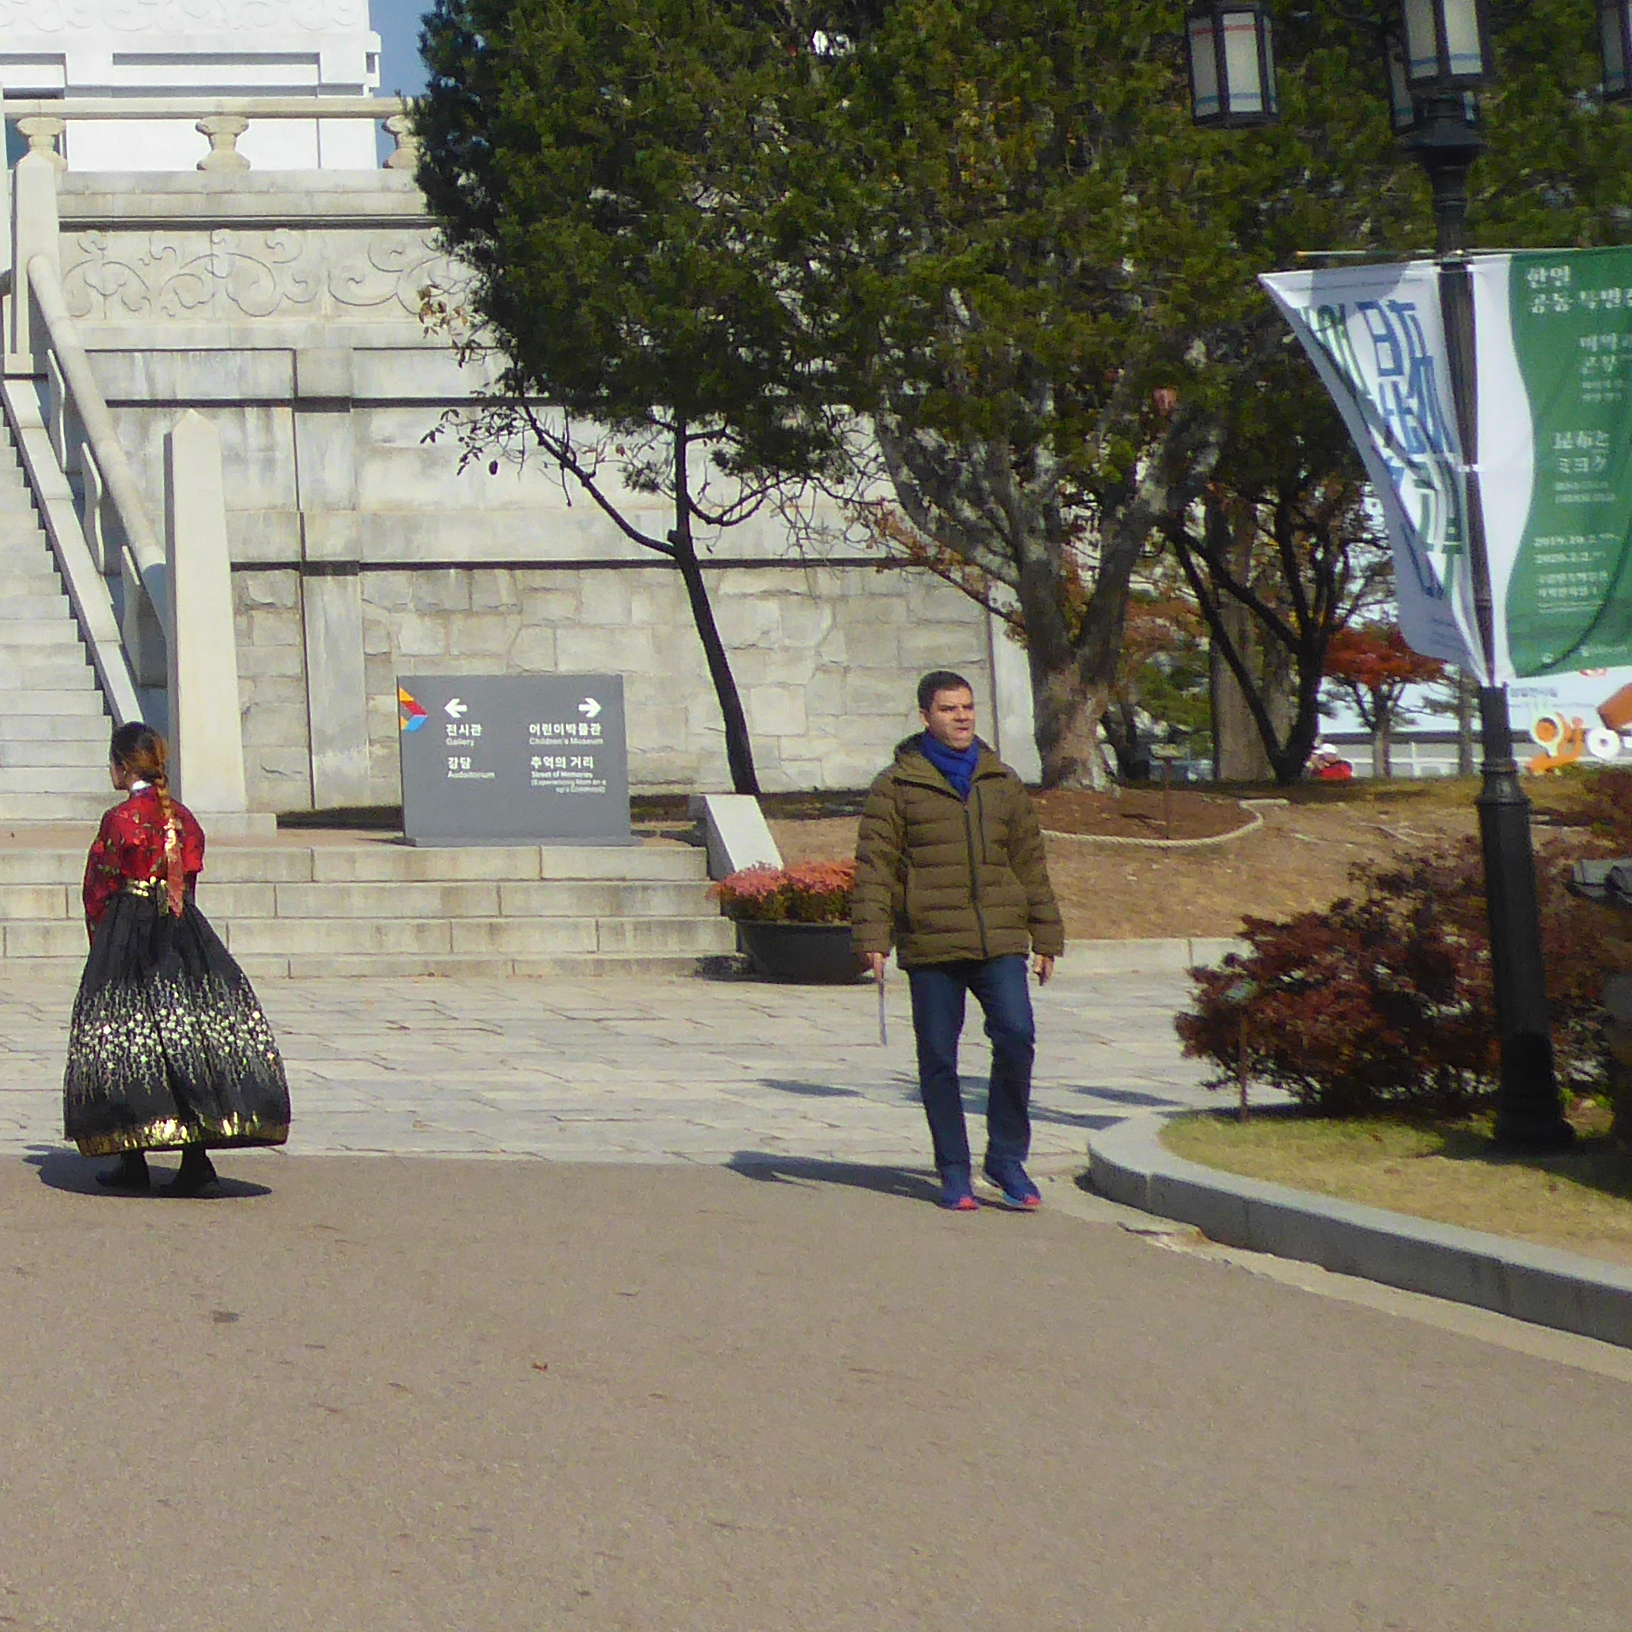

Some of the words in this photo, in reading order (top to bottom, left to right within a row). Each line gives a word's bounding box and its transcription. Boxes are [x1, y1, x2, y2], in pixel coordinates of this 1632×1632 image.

[446, 723, 483, 737] 전시관
[529, 723, 602, 737] 어린이박물관
[446, 737, 475, 747] Gallery
[570, 737, 604, 745] Museum
[448, 756, 472, 770] 강당
[531, 756, 566, 769] 추억의
[570, 756, 594, 770] 거리
